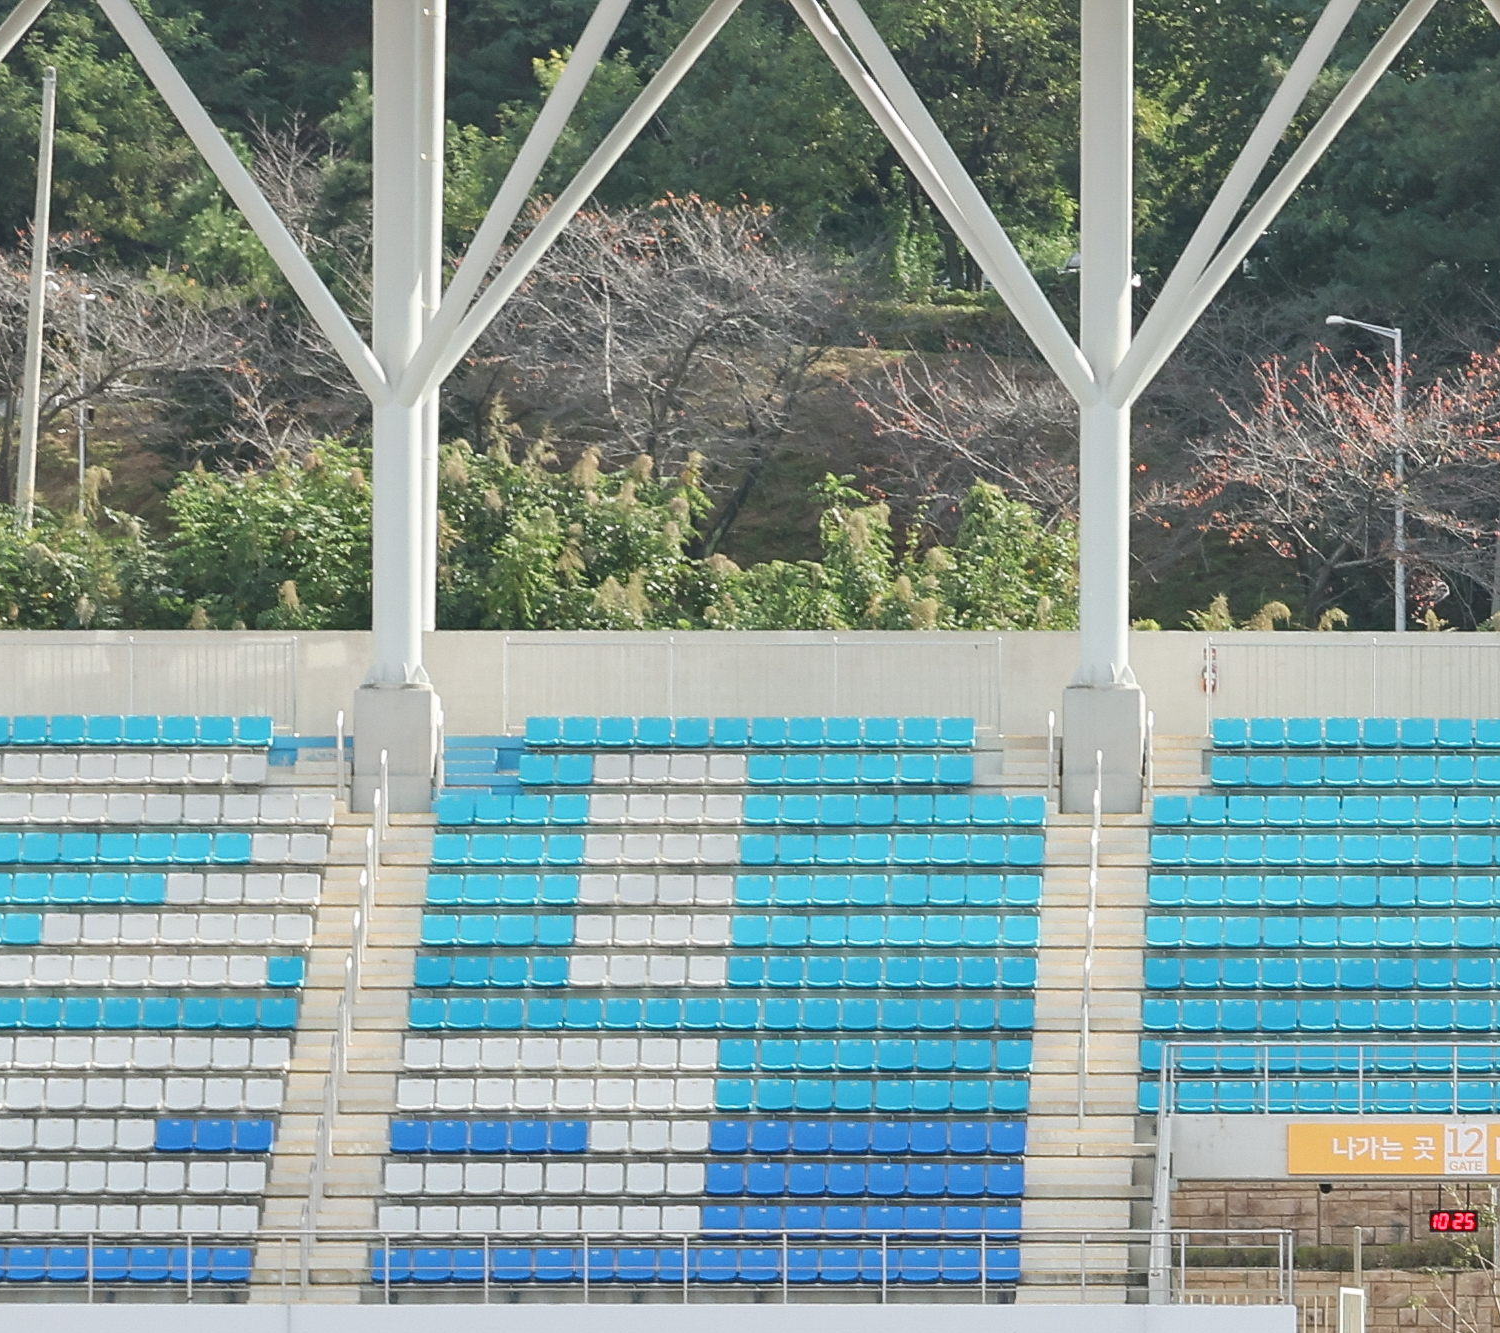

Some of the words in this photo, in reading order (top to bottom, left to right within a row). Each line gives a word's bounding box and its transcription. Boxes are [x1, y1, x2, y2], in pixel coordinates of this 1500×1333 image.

[1332, 1136, 1404, 1161] 나가는
[1412, 1136, 1436, 1162] 곳
[1447, 1127, 1485, 1157] 12
[1448, 1161, 1483, 1172] GATE
